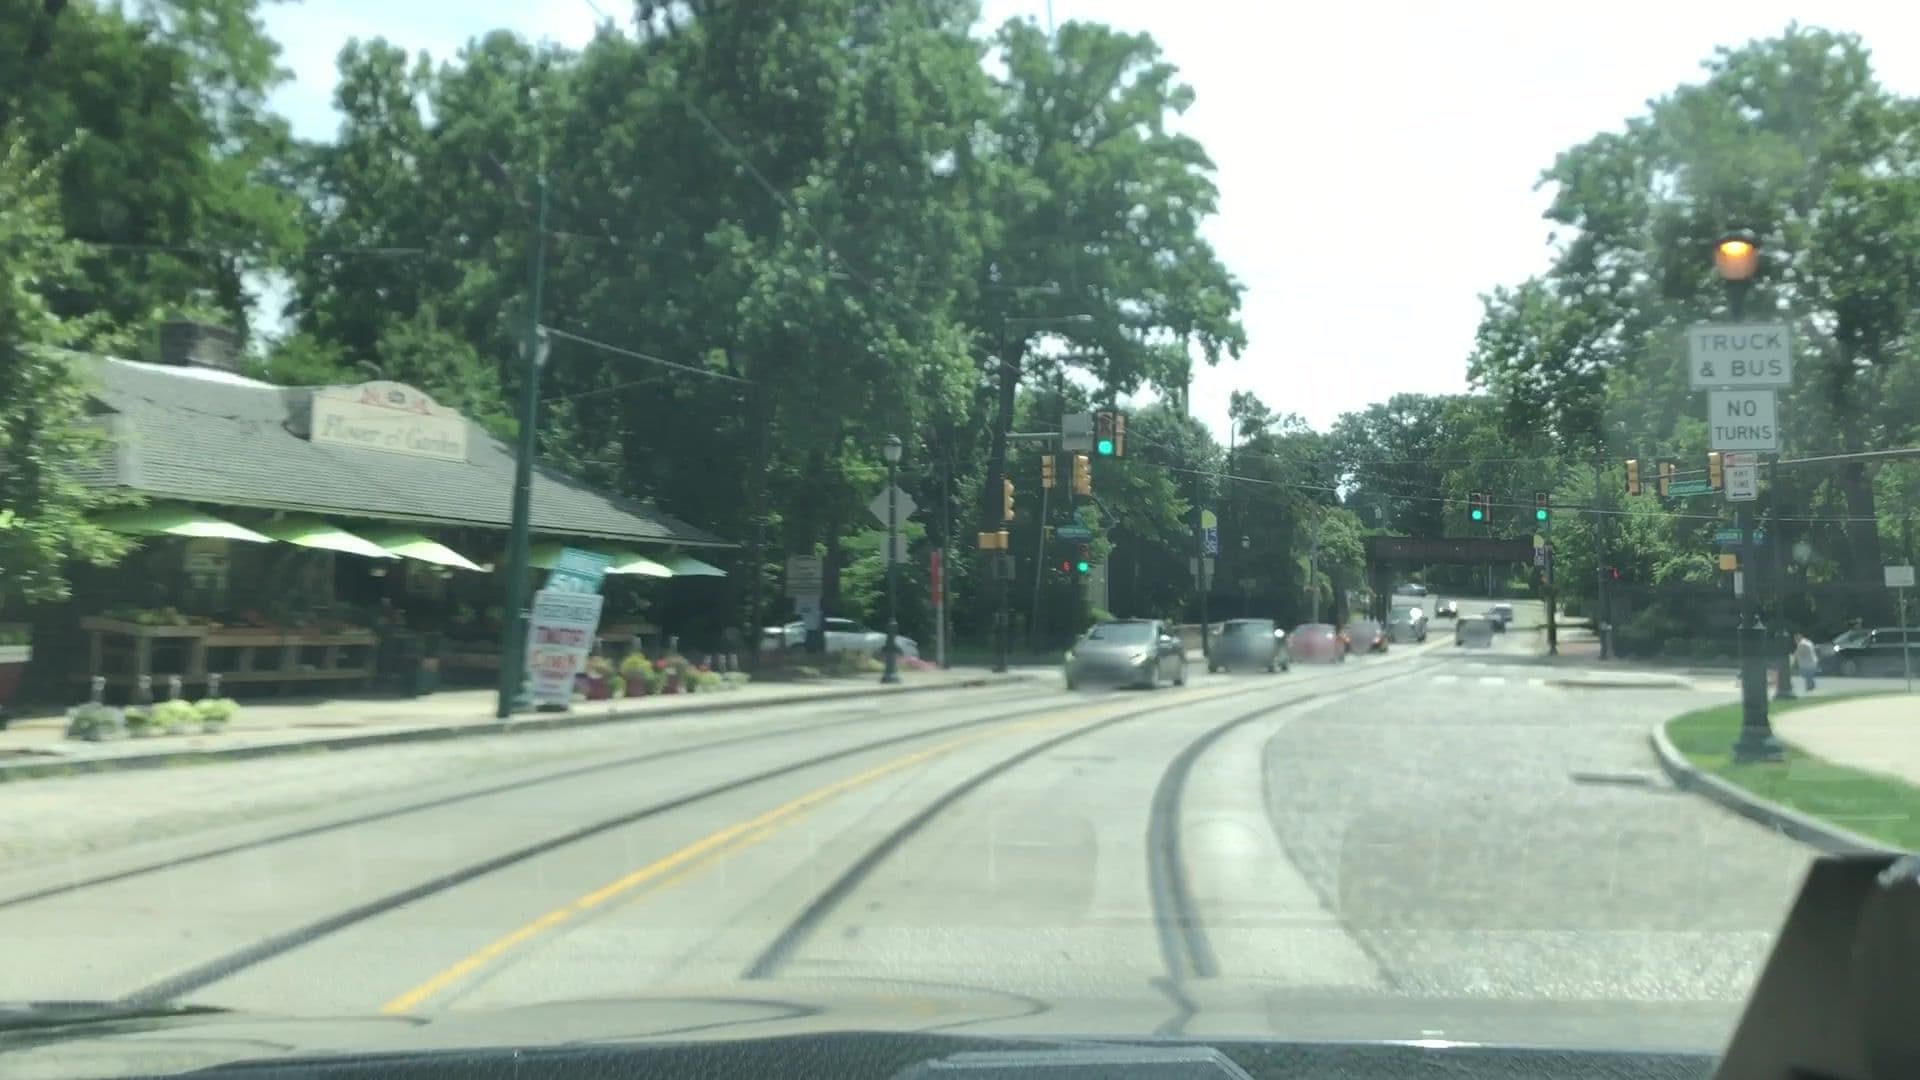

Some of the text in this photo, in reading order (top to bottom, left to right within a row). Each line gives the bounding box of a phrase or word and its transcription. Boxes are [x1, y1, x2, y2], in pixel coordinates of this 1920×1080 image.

[1700, 333, 1782, 350] TRUCK
[1700, 359, 1783, 377] & BUS
[1727, 399, 1757, 417] NO
[1714, 426, 1773, 441] TURNS
